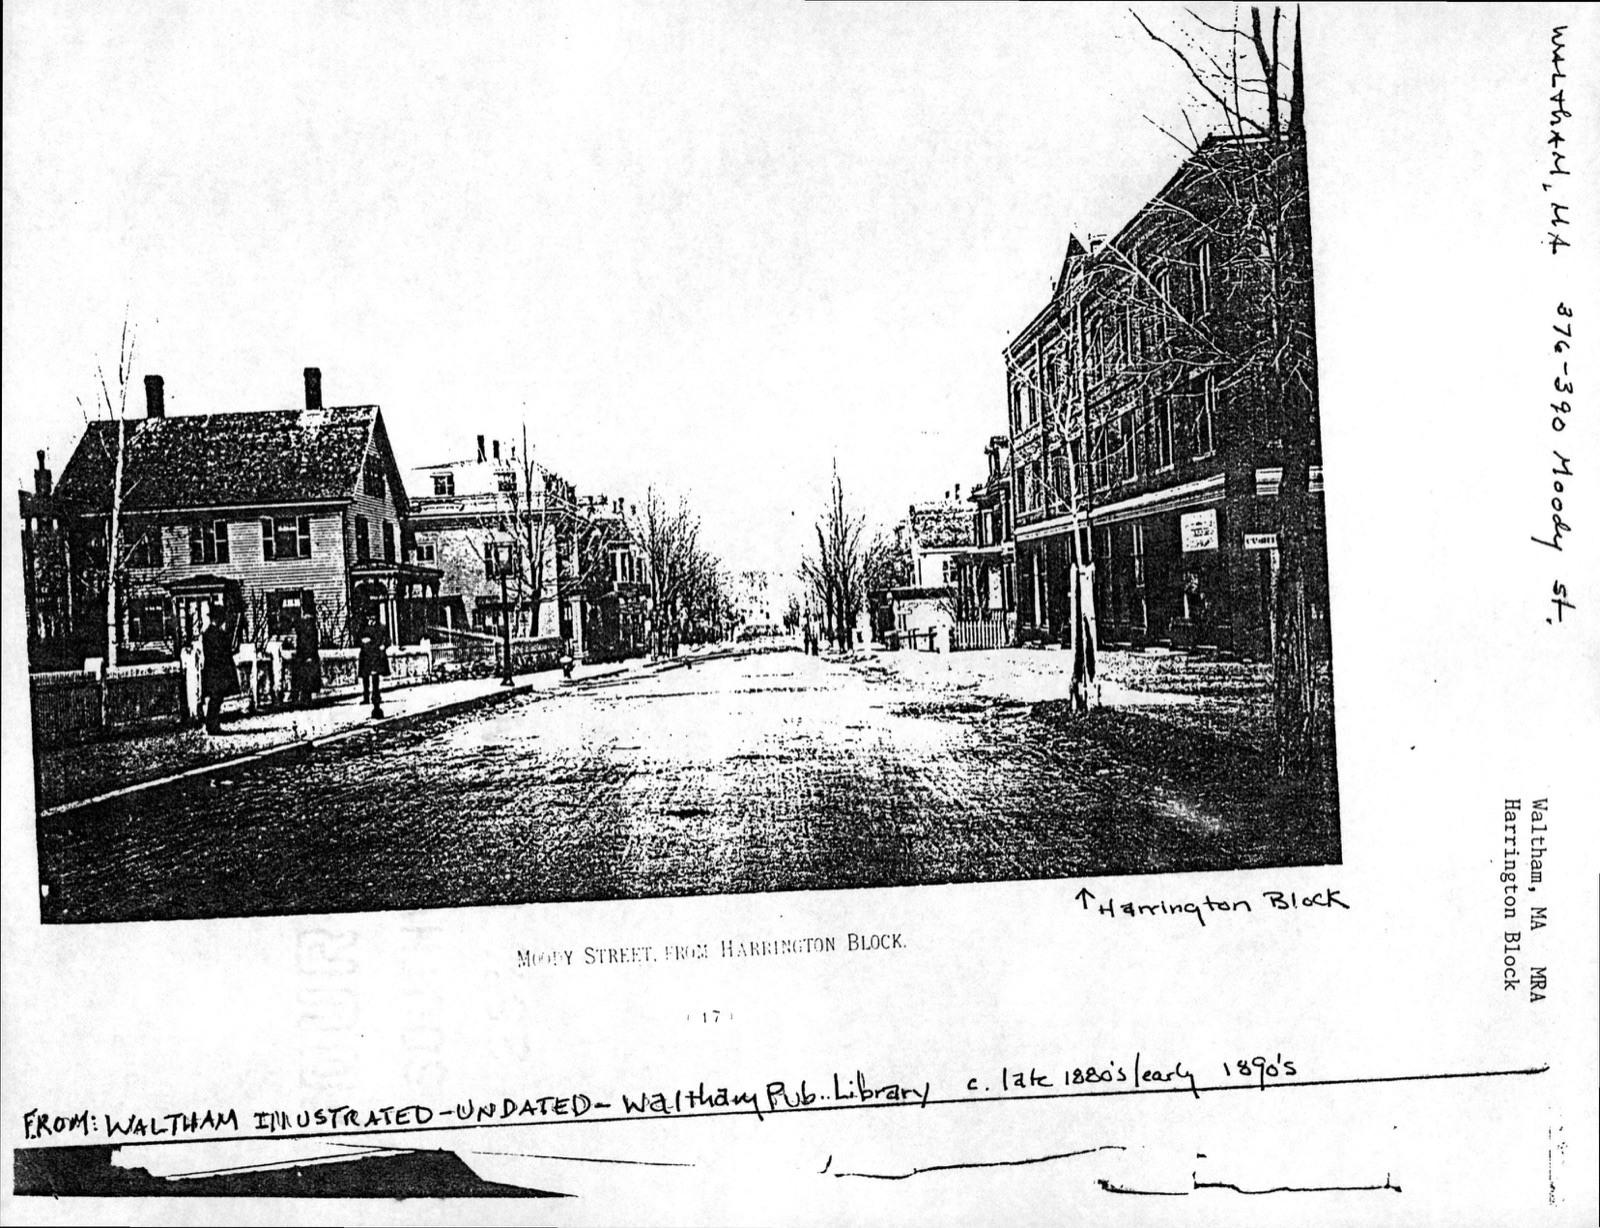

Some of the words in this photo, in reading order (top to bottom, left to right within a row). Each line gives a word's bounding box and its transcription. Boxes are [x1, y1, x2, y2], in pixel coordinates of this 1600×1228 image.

[1545, 203, 1570, 254] MA
[1551, 302, 1574, 431] 376-390
[1531, 451, 1573, 551] Moody
[1500, 799, 1521, 918] Harrington
[1528, 798, 1548, 891] Waltham,
[1099, 896, 1251, 926] Harrington
[1263, 888, 1350, 909] Block
[1530, 907, 1547, 930] MA
[722, 937, 835, 958] HARRINGTON
[848, 932, 907, 951] BLOCK.
[1503, 932, 1521, 990] Block
[1530, 967, 1546, 1003] MRA
[24, 1108, 99, 1139] FROM:
[105, 1108, 239, 1137] WALTHAM
[834, 1070, 930, 1108] Library
[1003, 1066, 1053, 1091] late
[1223, 1052, 1298, 1091] 1890's
